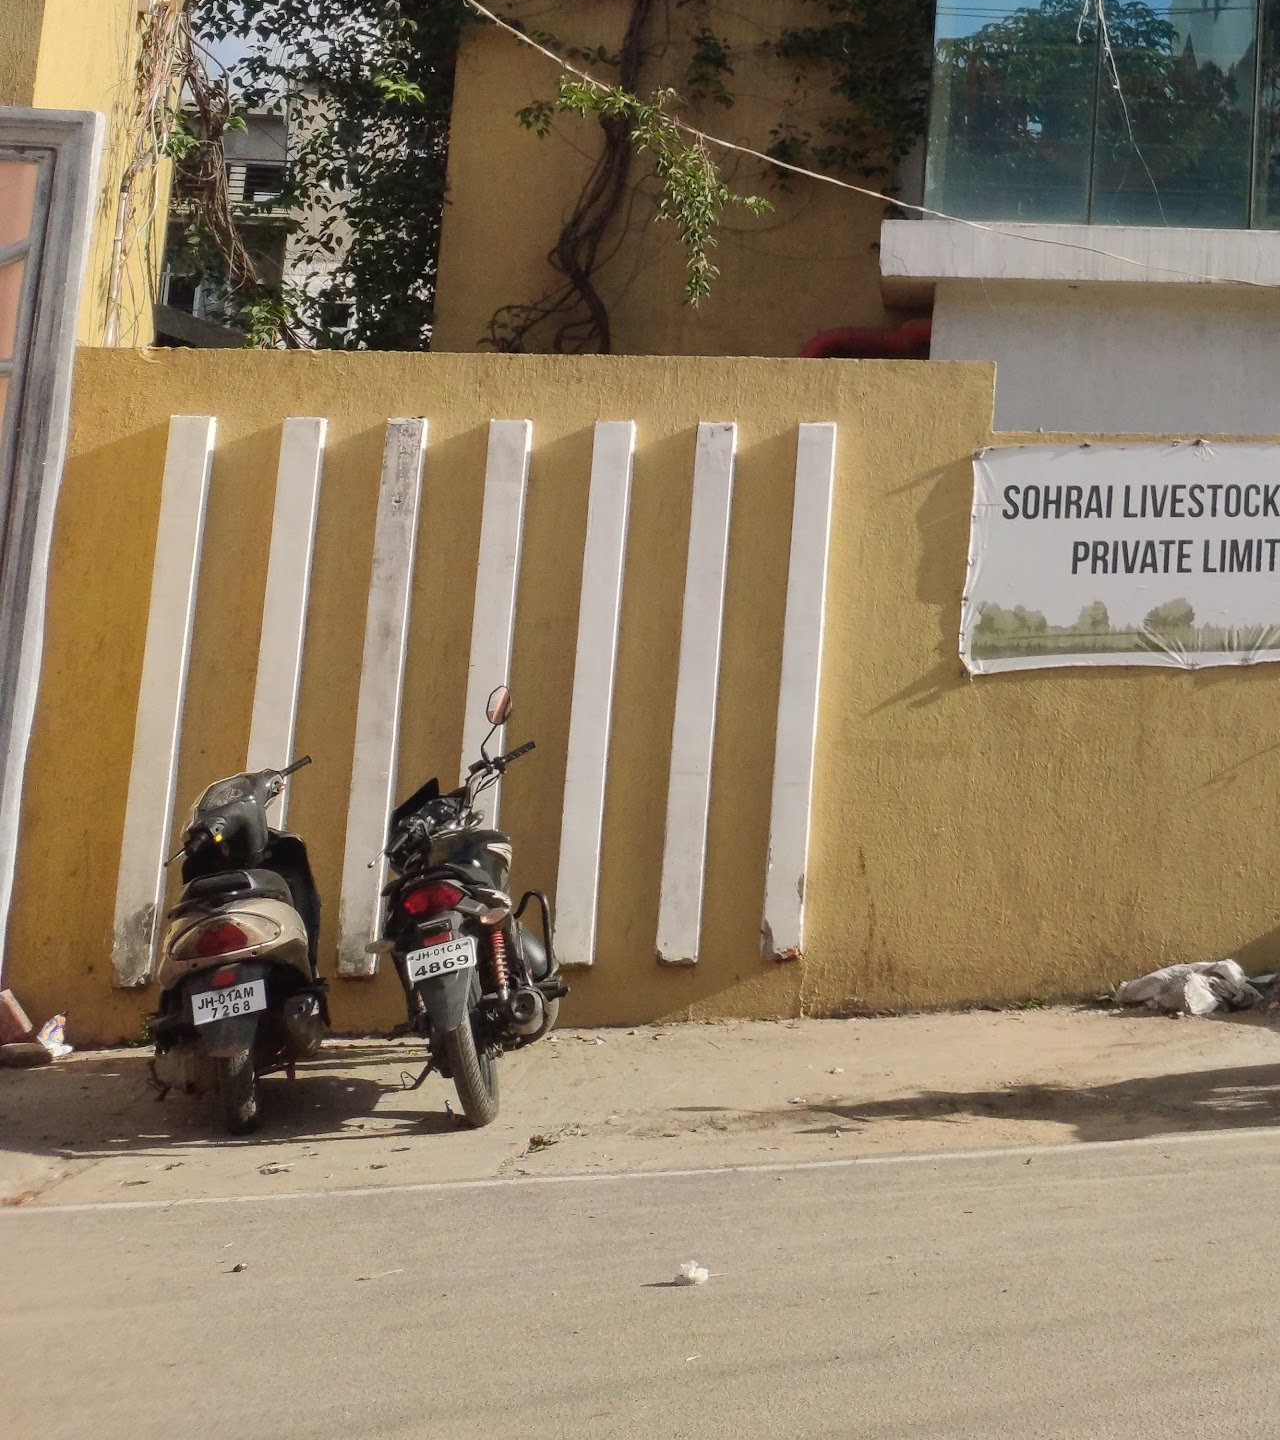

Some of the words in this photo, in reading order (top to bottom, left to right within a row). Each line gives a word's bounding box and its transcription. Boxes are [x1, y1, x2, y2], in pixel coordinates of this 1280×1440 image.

[1002, 484, 1113, 520] SOHRAI
[1123, 483, 1280, 518] LIVESTOCK
[1071, 540, 1194, 575] PRIVATE
[416, 944, 462, 962] JH-01CA
[414, 954, 469, 977] 4869
[211, 1001, 251, 1019] 7268
